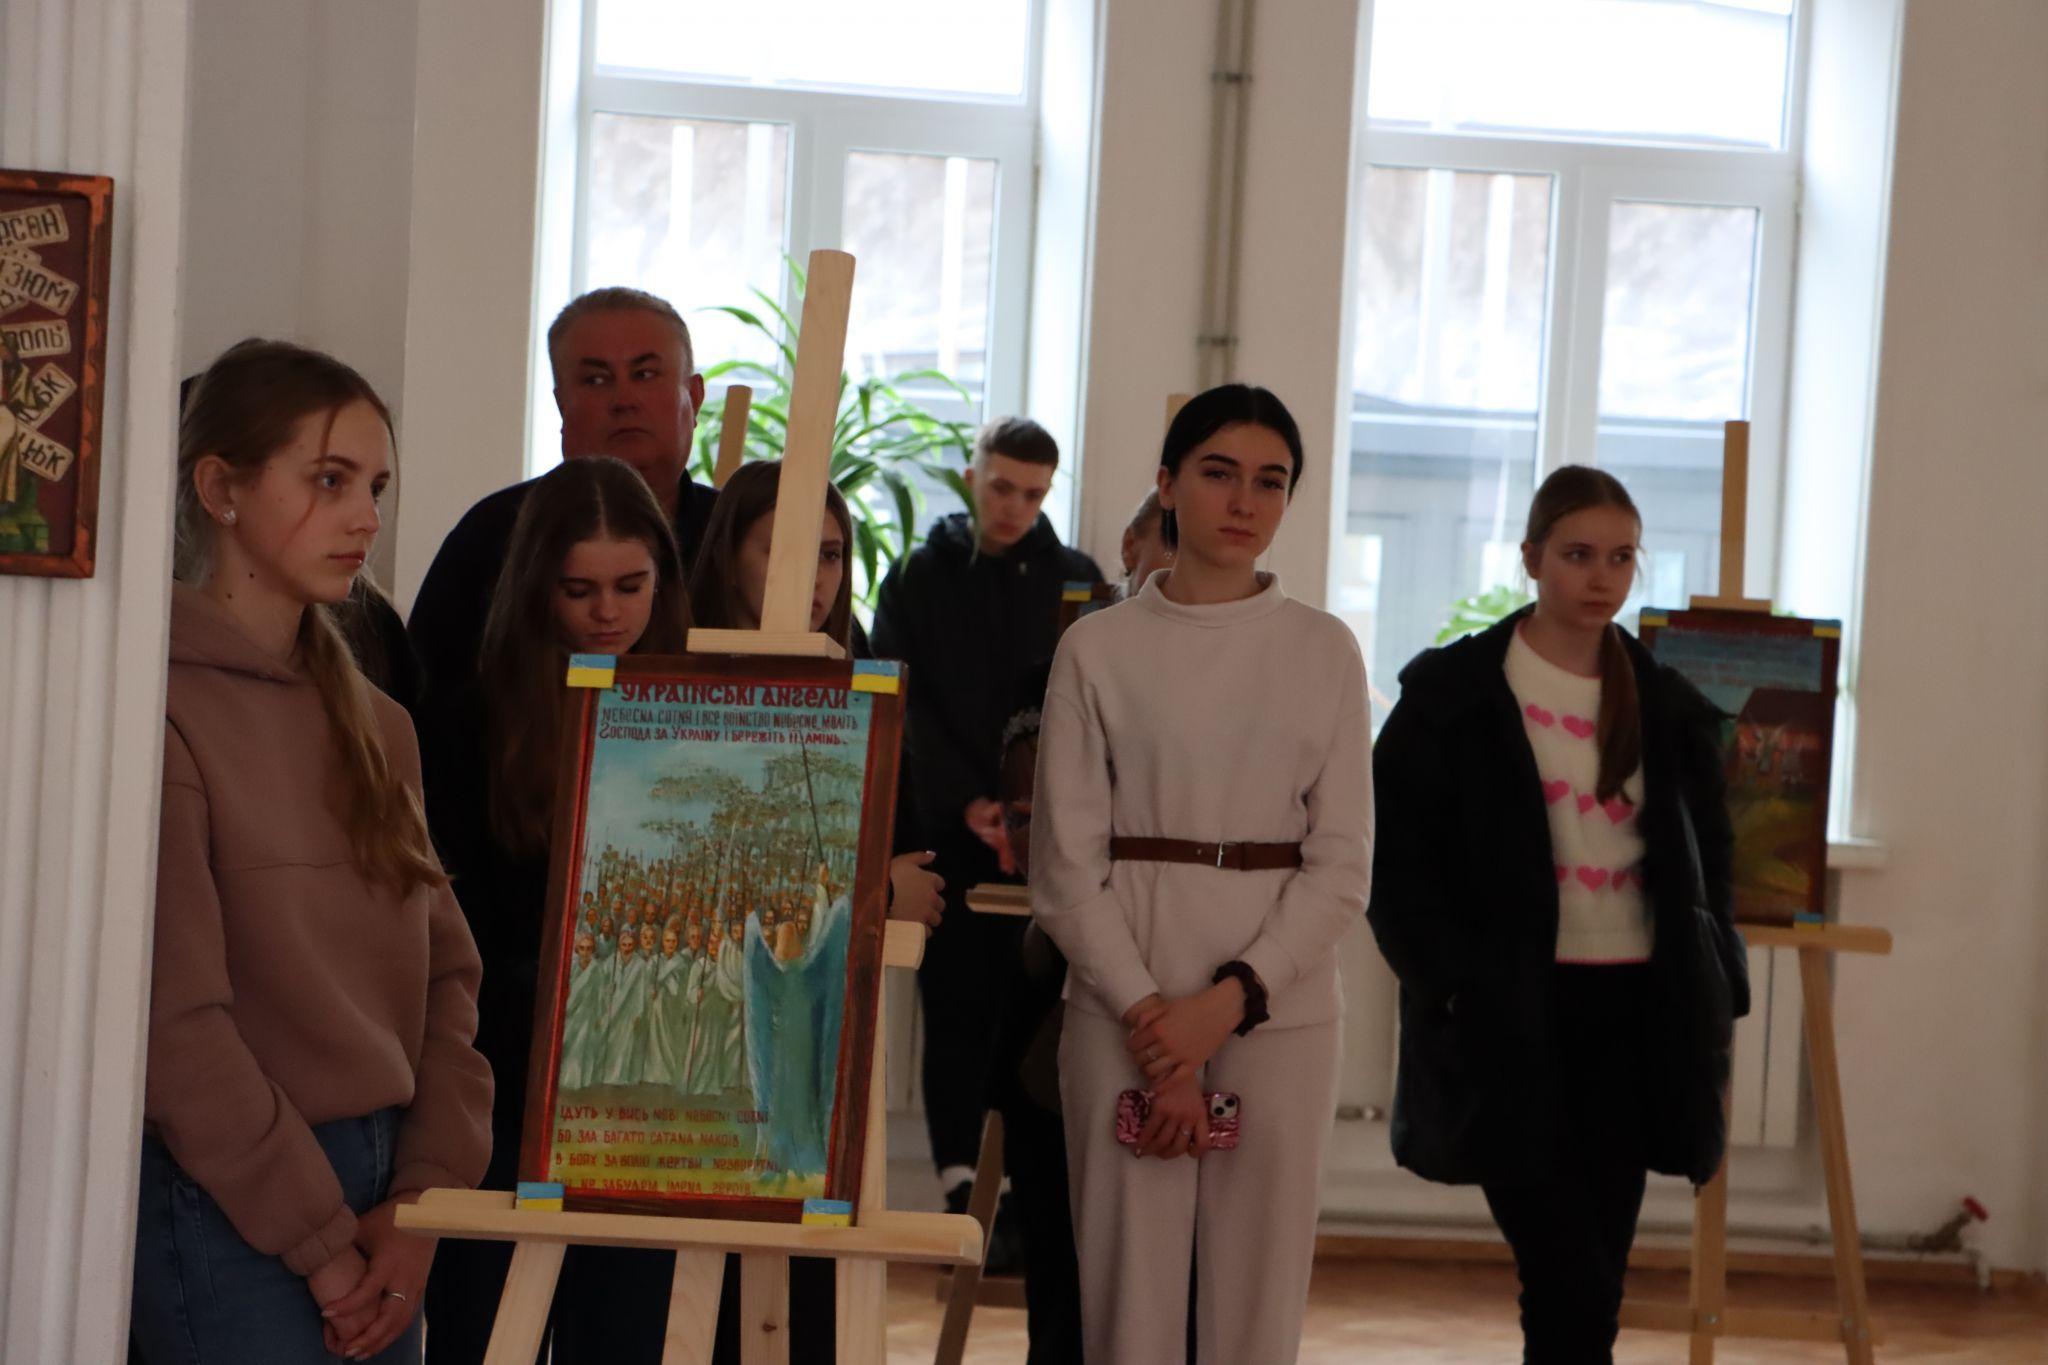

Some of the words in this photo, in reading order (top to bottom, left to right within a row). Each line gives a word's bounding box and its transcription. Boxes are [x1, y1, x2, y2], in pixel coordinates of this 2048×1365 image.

[602, 707, 654, 724] НЕБЕСНА
[658, 709, 692, 726] СОТНЯ
[702, 710, 720, 727] ВСЕ
[655, 727, 668, 741] ЗА
[672, 725, 720, 742] УКРАЇНУ
[731, 730, 785, 744] БЕРЕЖІТЬ
[605, 1106, 615, 1120] У
[558, 1128, 571, 1143] БО
[578, 1129, 598, 1144] ЗЛА
[603, 1130, 645, 1144] БАГАТО
[650, 1131, 694, 1145] САТАНА
